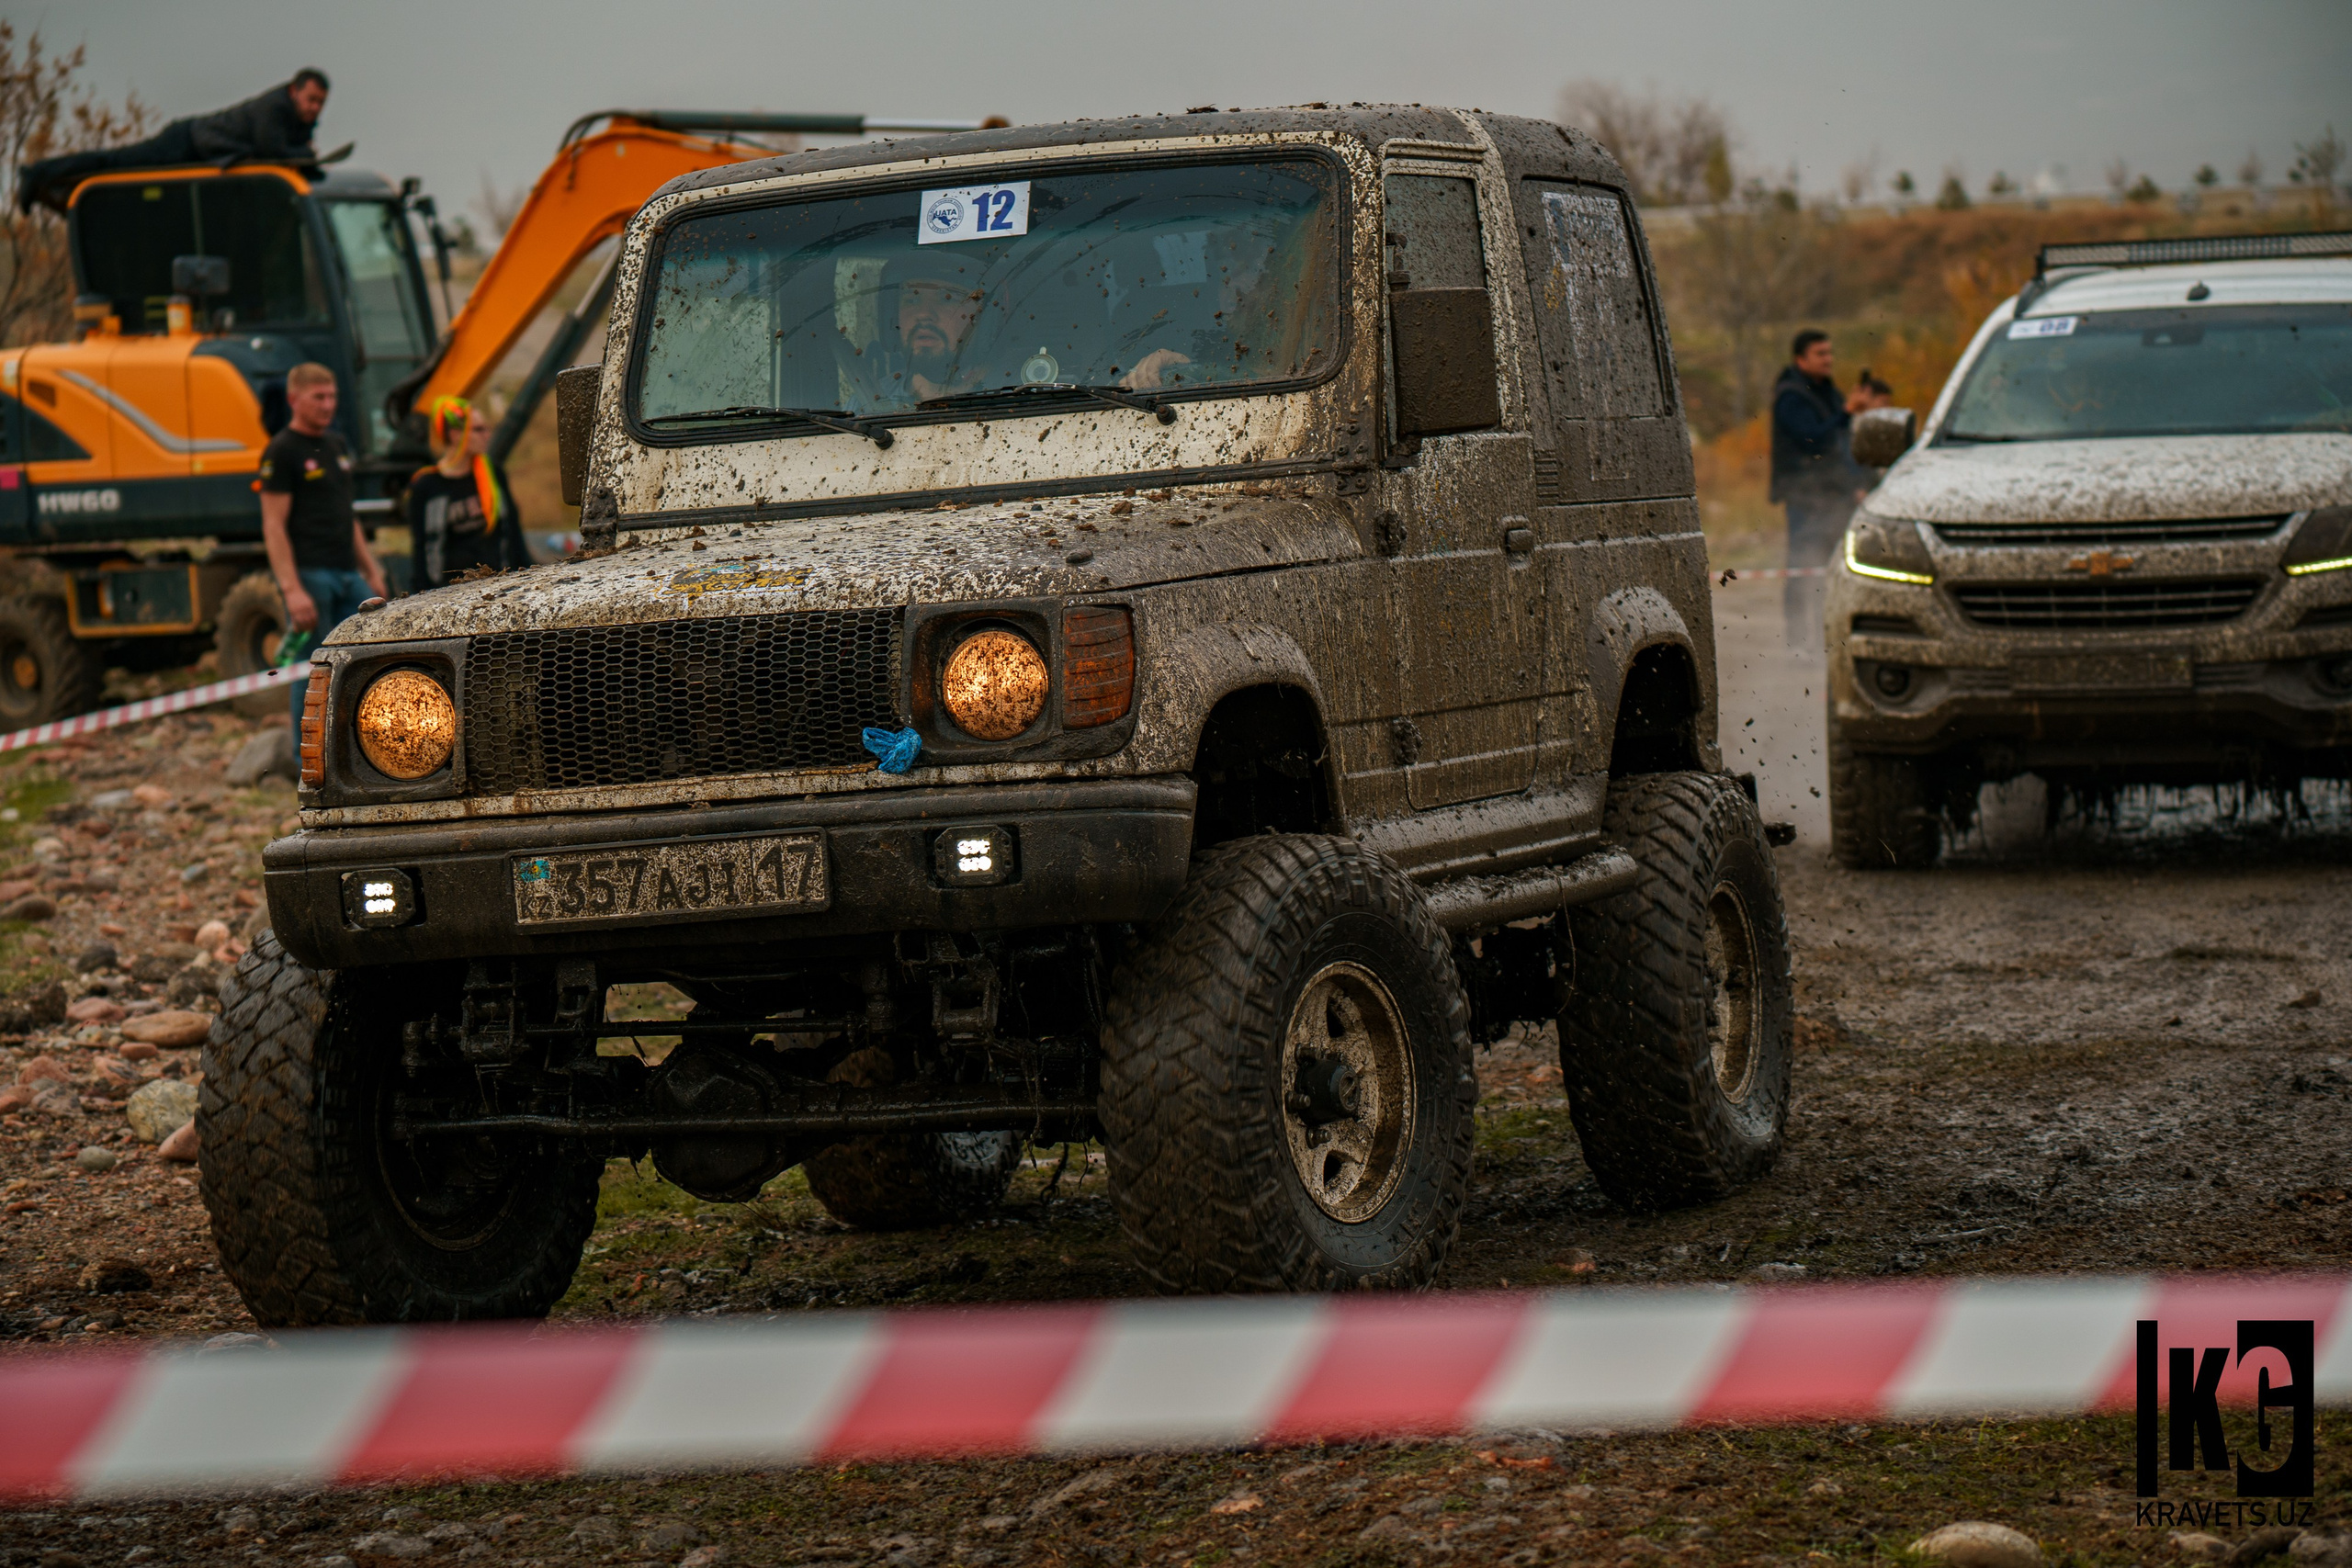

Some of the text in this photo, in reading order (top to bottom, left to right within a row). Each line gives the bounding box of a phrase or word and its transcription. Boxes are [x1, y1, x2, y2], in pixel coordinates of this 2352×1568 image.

[935, 209, 957, 217] UATA
[972, 189, 1015, 232] 12
[555, 857, 645, 914] 357
[758, 843, 816, 901] 17
